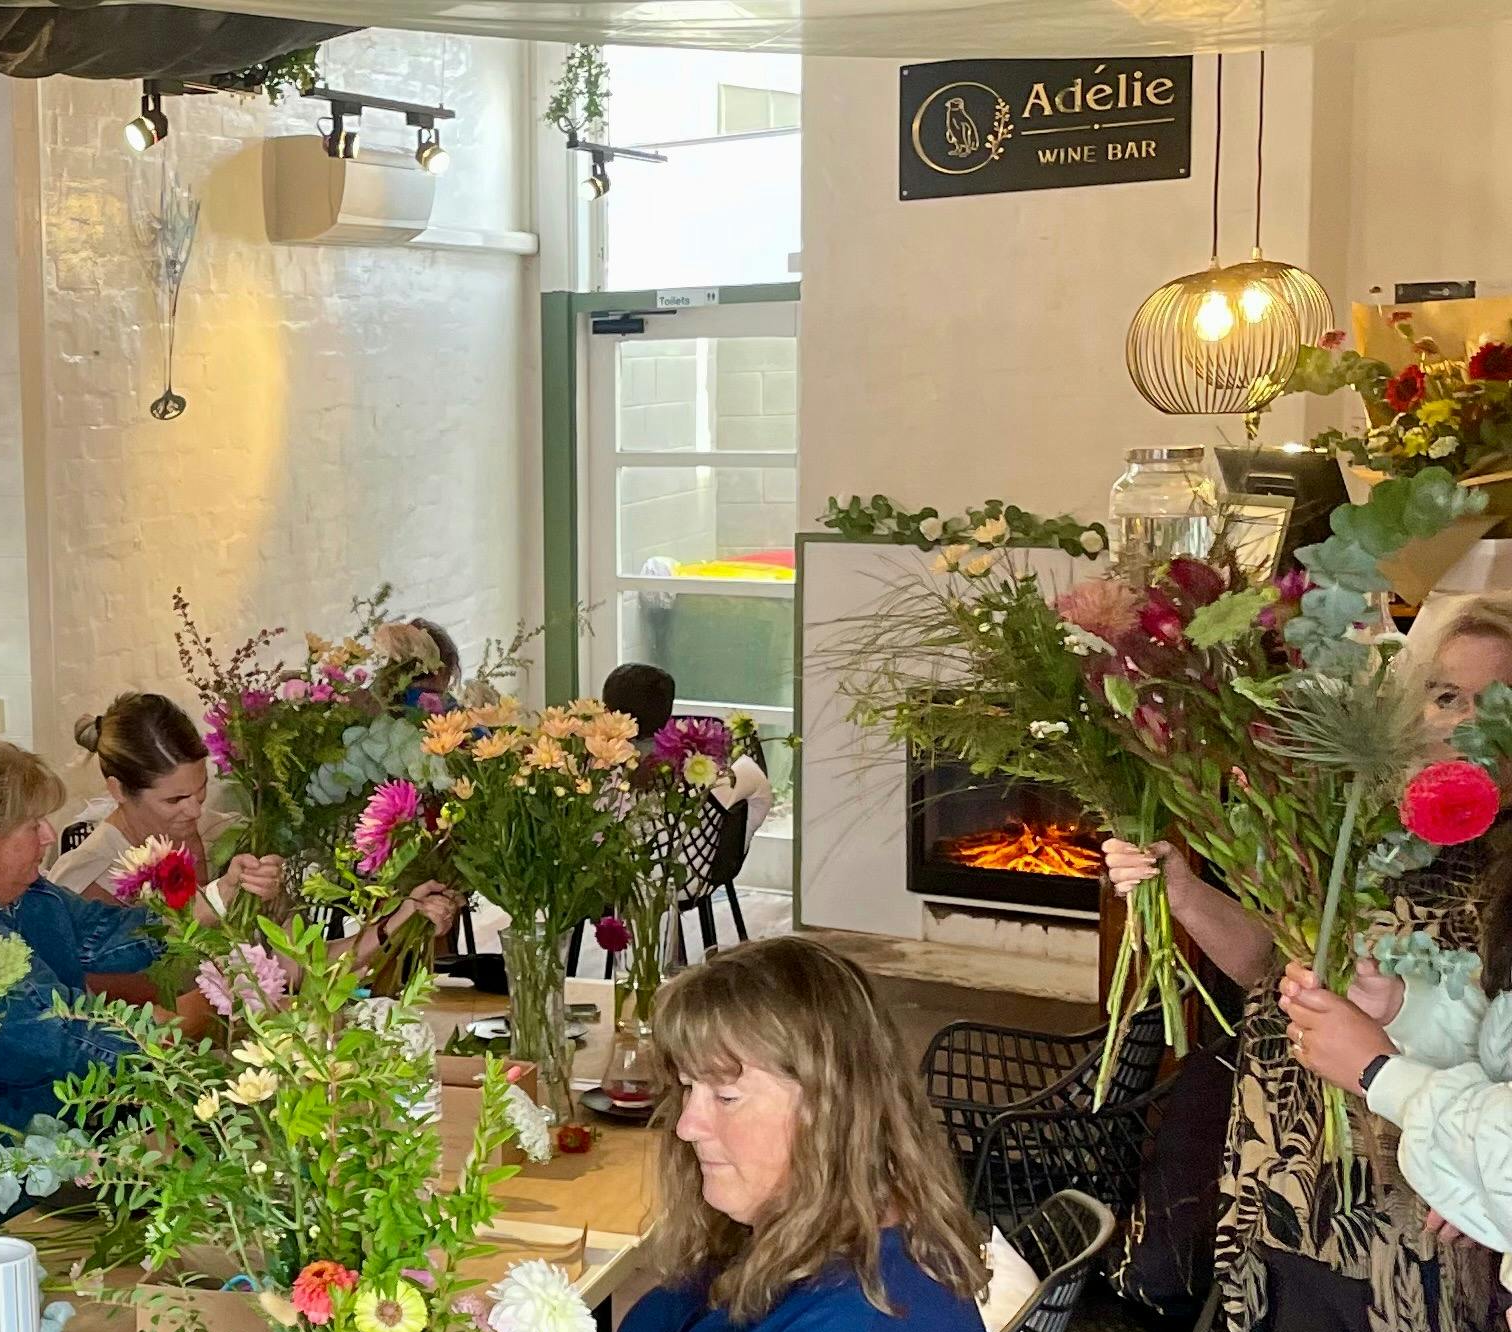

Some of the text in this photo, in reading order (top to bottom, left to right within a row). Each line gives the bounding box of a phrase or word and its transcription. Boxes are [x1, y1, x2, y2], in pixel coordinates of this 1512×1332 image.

[1021, 64, 1175, 118] Adélie
[1038, 140, 1156, 164] WINE BAR
[659, 295, 690, 306] Toilets
